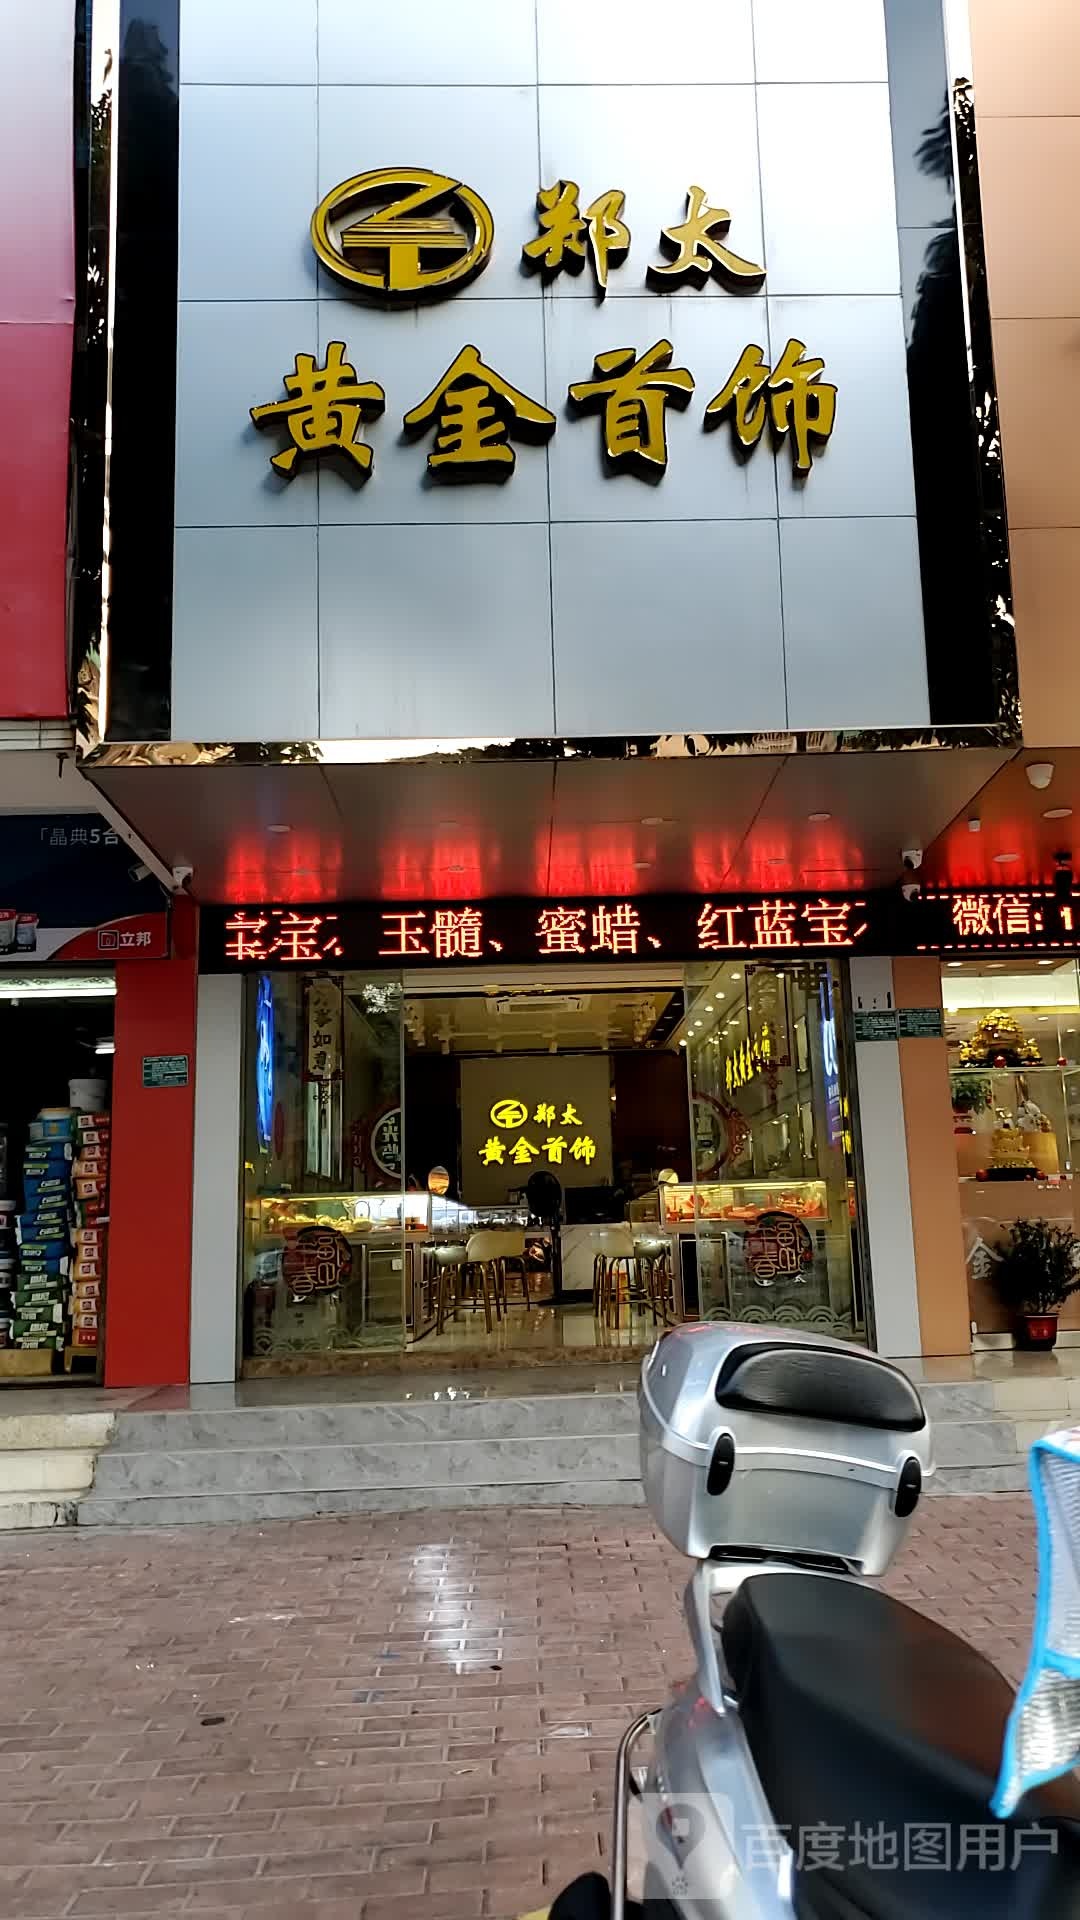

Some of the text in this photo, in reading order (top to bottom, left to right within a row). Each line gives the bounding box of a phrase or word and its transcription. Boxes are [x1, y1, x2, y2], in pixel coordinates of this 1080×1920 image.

[522, 179, 767, 302] 郑太
[249, 338, 838, 481] 黄金首饰
[119, 931, 152, 947] 立邦
[533, 1102, 583, 1129] 郑太
[478, 1135, 596, 1166] 黄金首饰
